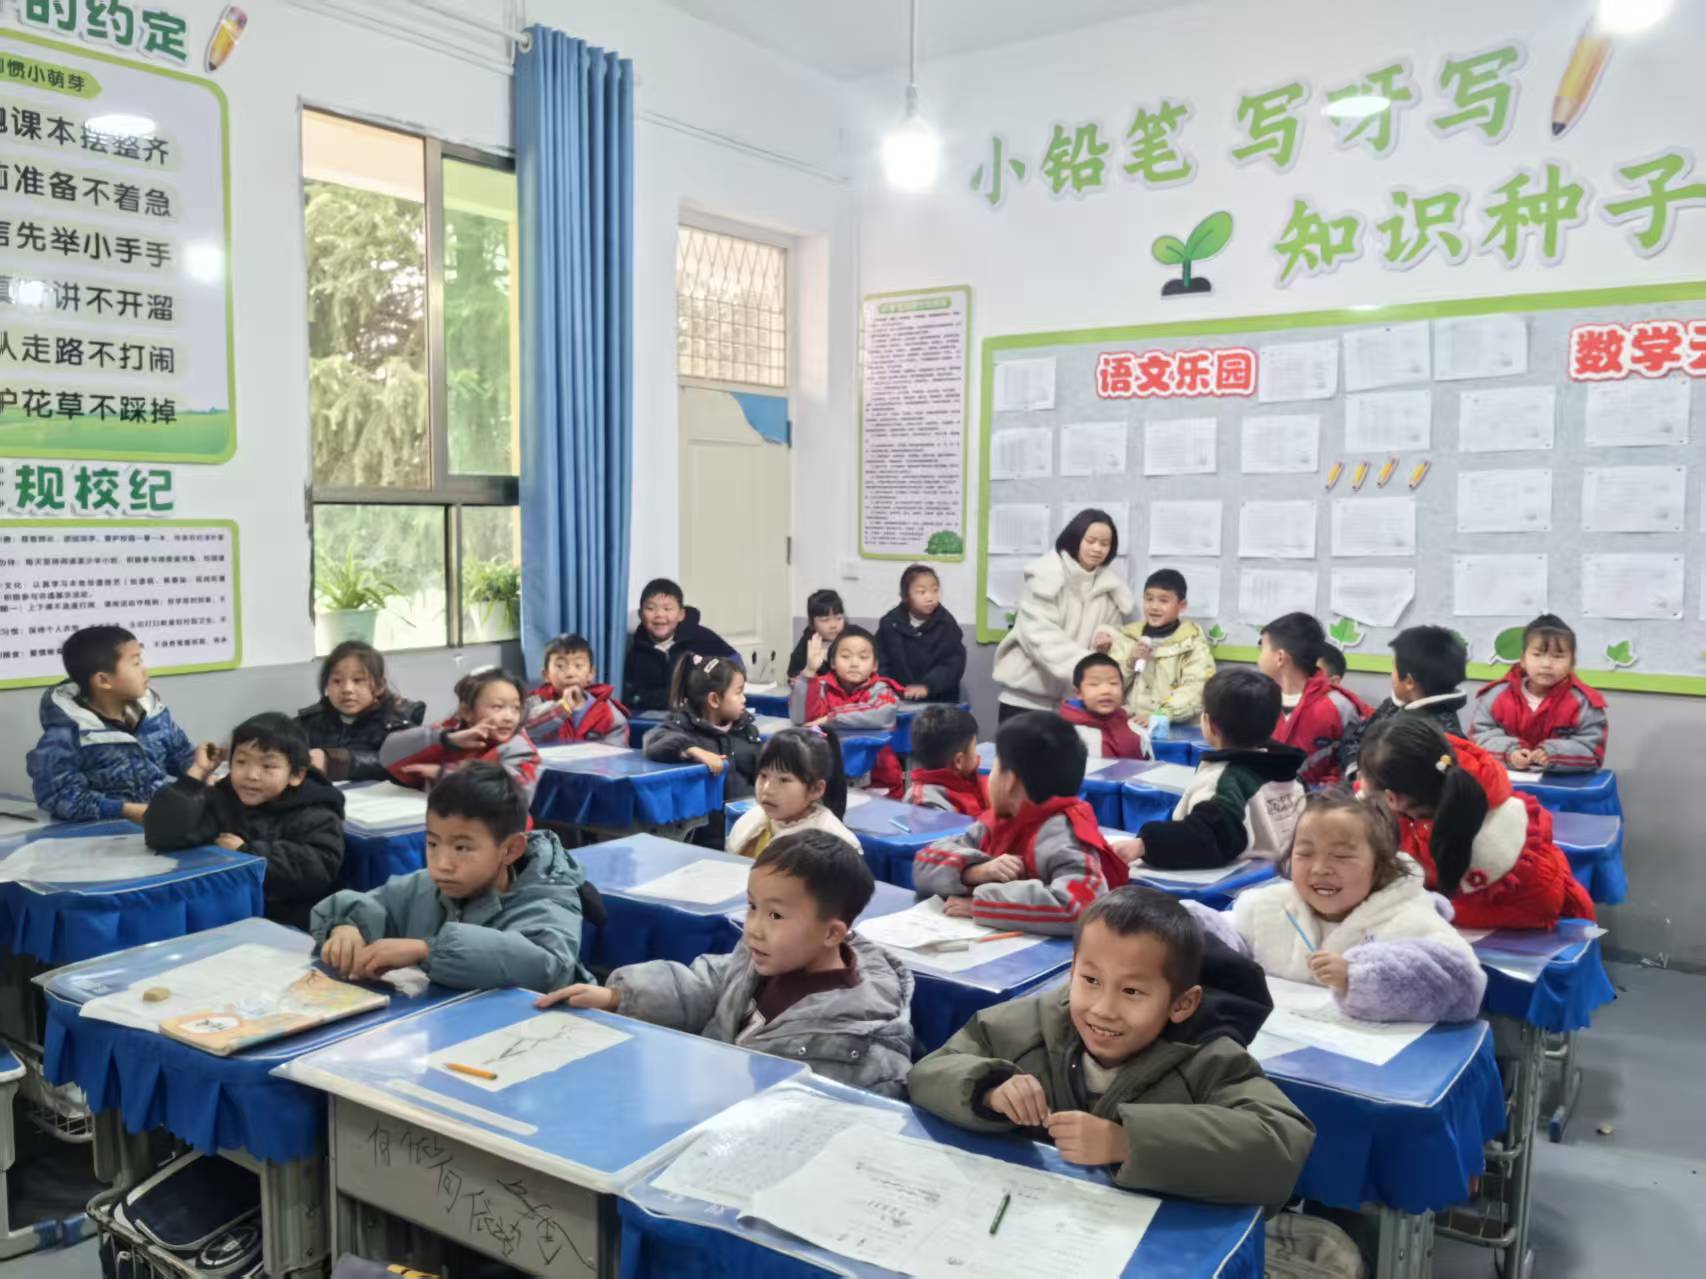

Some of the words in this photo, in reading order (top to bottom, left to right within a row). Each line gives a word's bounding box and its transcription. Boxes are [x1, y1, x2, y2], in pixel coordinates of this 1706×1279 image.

[26, 0, 187, 62] 的约定
[0, 57, 86, 92] 惯小萌芽
[1275, 153, 1706, 283] 知识种子
[0, 275, 173, 321] 讲不开溜
[1100, 353, 1254, 393] 语文乐园
